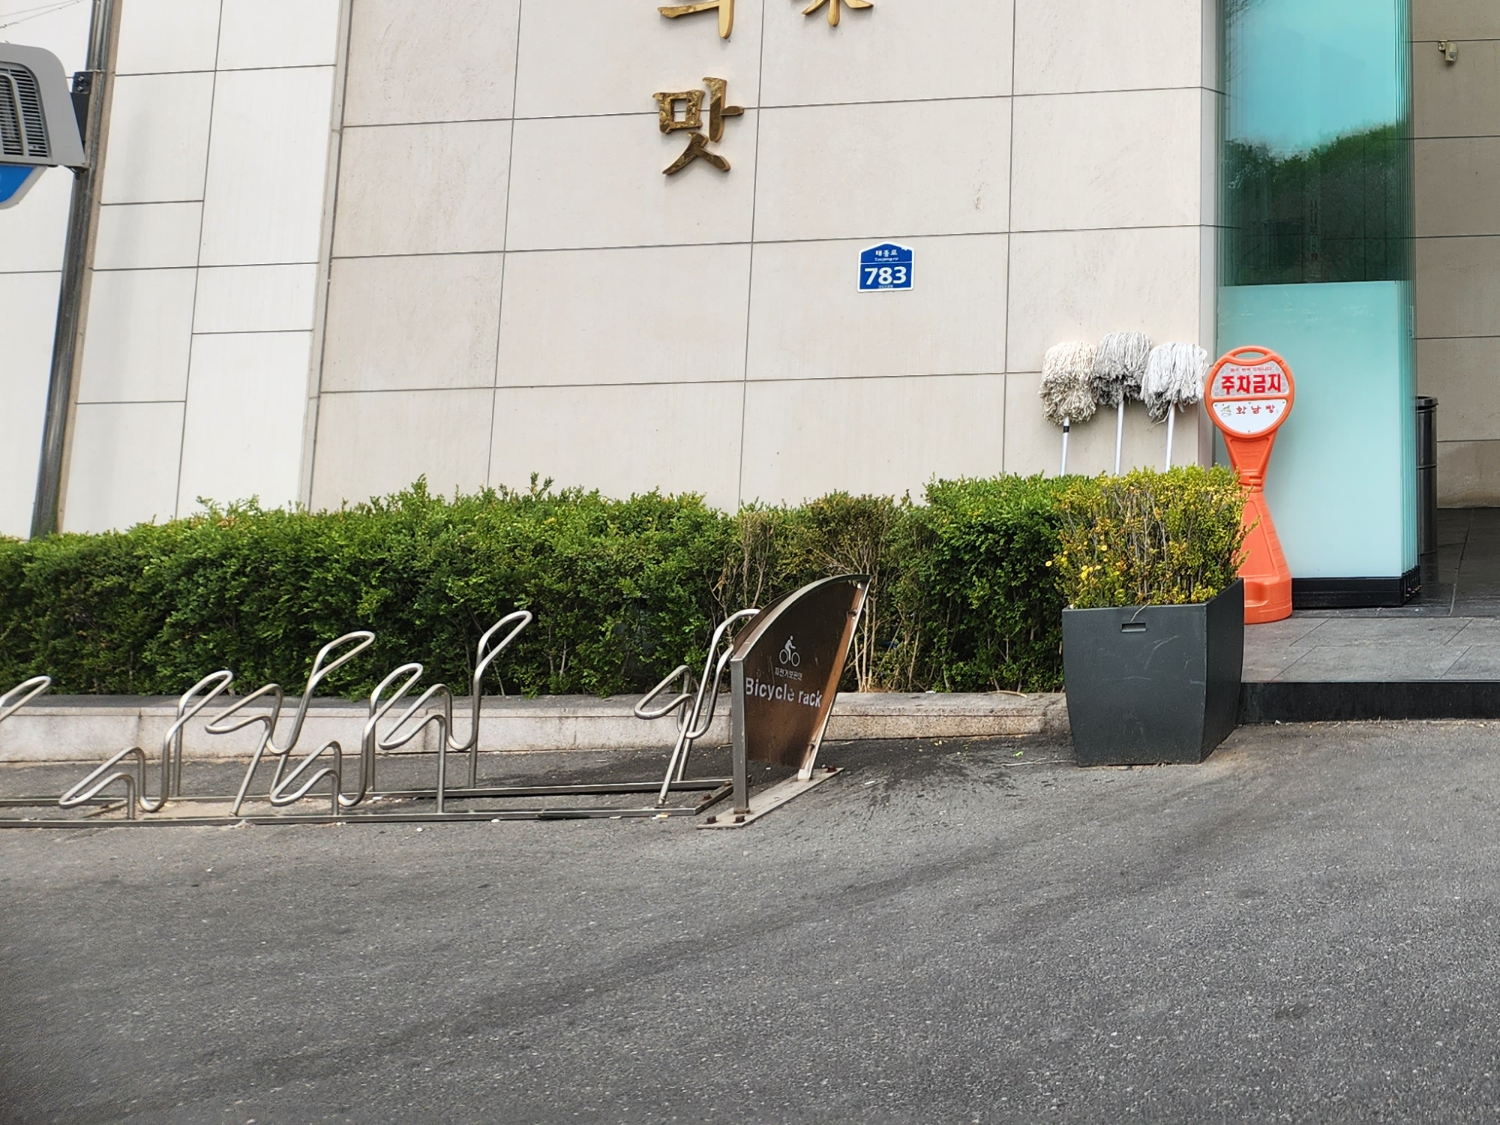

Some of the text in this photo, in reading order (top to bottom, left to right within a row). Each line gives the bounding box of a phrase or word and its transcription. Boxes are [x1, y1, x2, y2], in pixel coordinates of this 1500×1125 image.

[652, 76, 745, 176] 맛
[864, 266, 907, 286] 783
[1221, 374, 1282, 395] 주차금지
[1235, 404, 1275, 415] 황남빵
[745, 676, 823, 708] Bicycle rack
